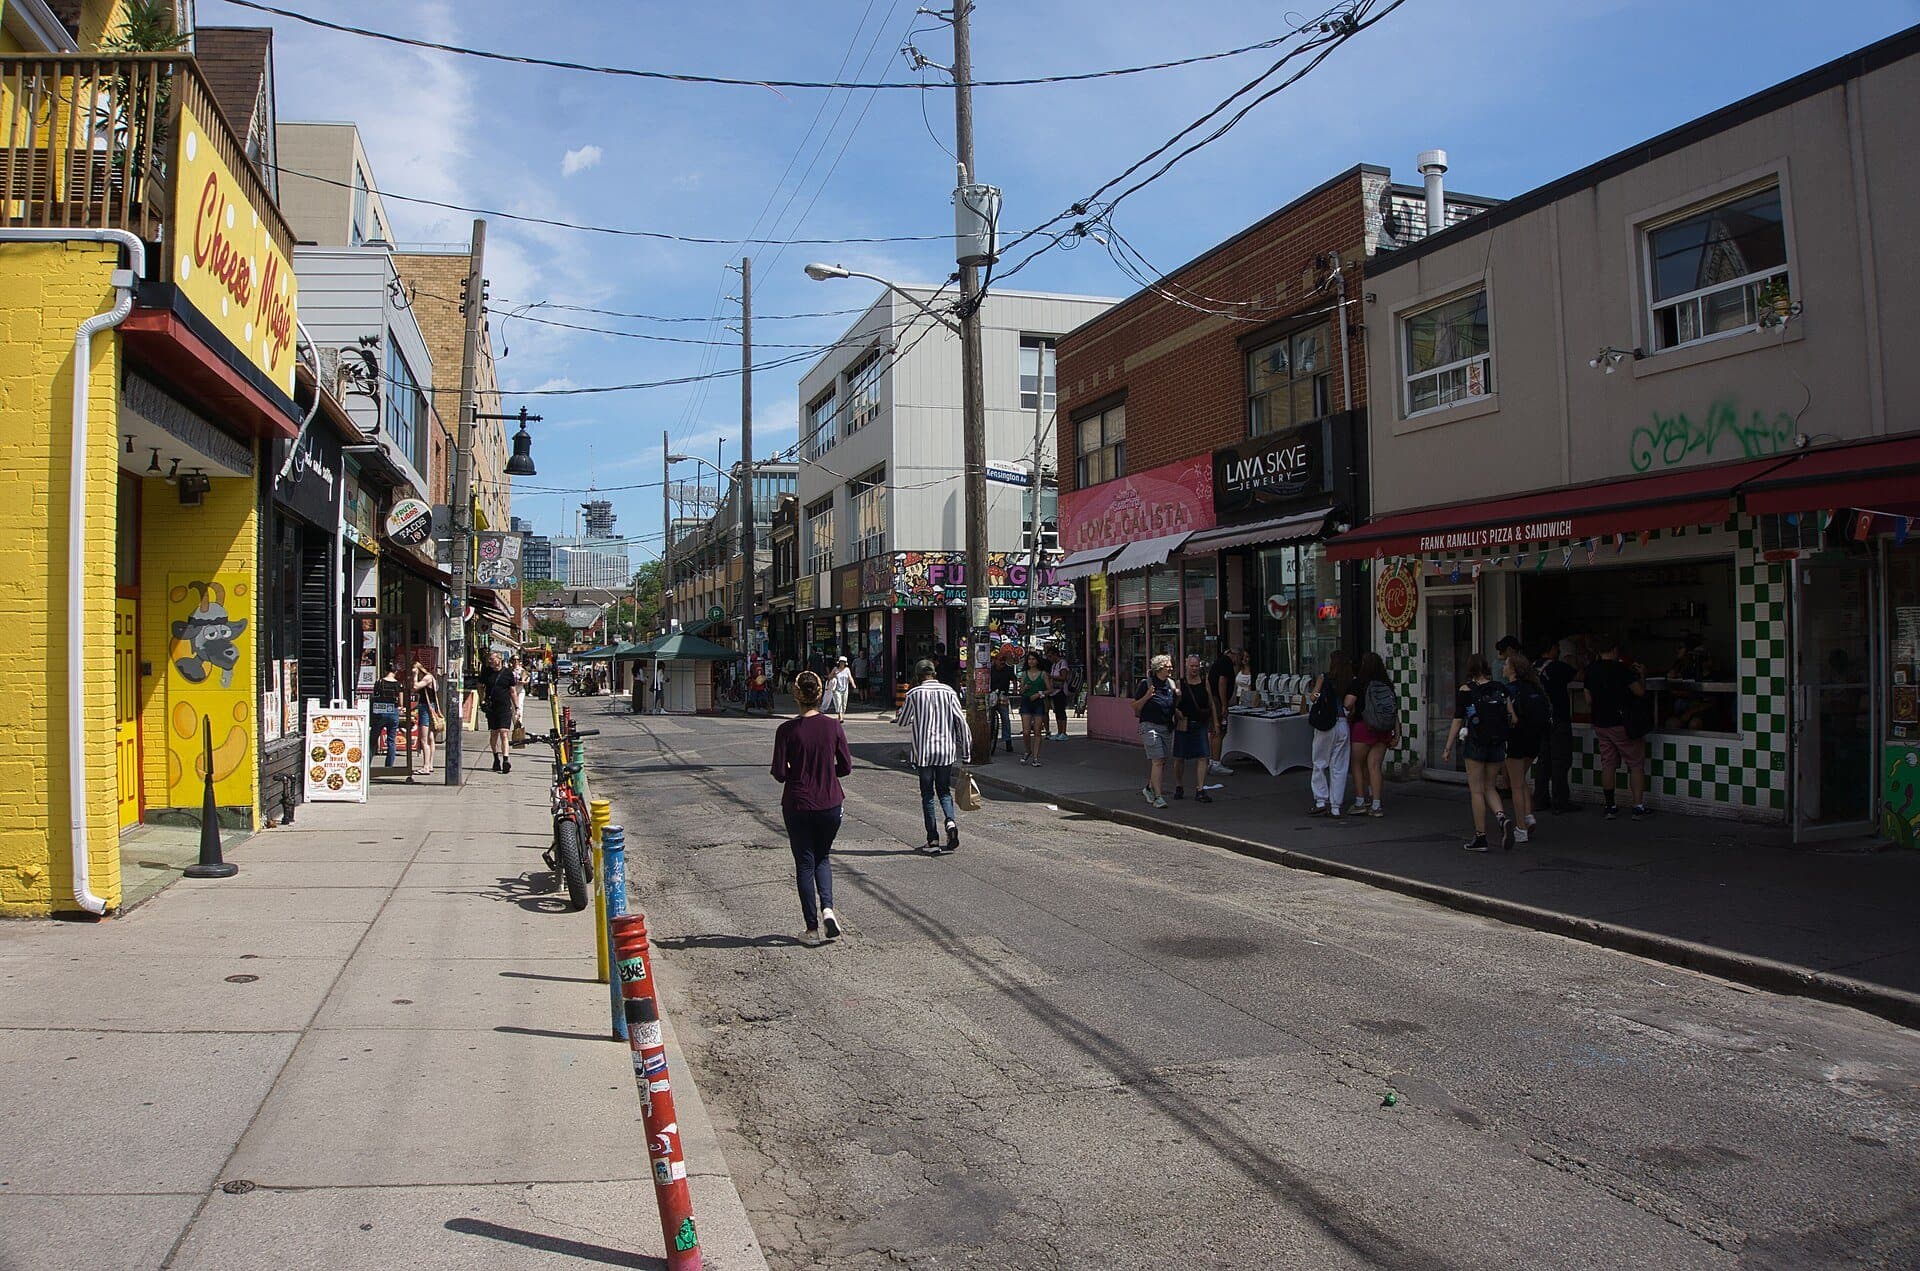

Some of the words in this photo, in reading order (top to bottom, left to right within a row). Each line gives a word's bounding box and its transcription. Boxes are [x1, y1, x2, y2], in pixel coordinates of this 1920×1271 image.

[194, 171, 252, 309] Cheese
[255, 250, 291, 371] Magic
[986, 468, 1020, 482] Kensington
[1226, 456, 1264, 484] LAYA
[1266, 444, 1306, 474] SKYE
[1239, 472, 1292, 491] JEWELRY
[399, 516, 427, 538] TACOS
[1122, 502, 1187, 534] CALISTA
[1420, 536, 1446, 550] FRANK
[1446, 530, 1487, 548] RANALLI'S
[1489, 528, 1513, 544] PIZZA
[1515, 526, 1522, 540] &
[1525, 520, 1572, 540] SANDWICH
[930, 564, 964, 585] FU
[946, 590, 967, 598] MAG
